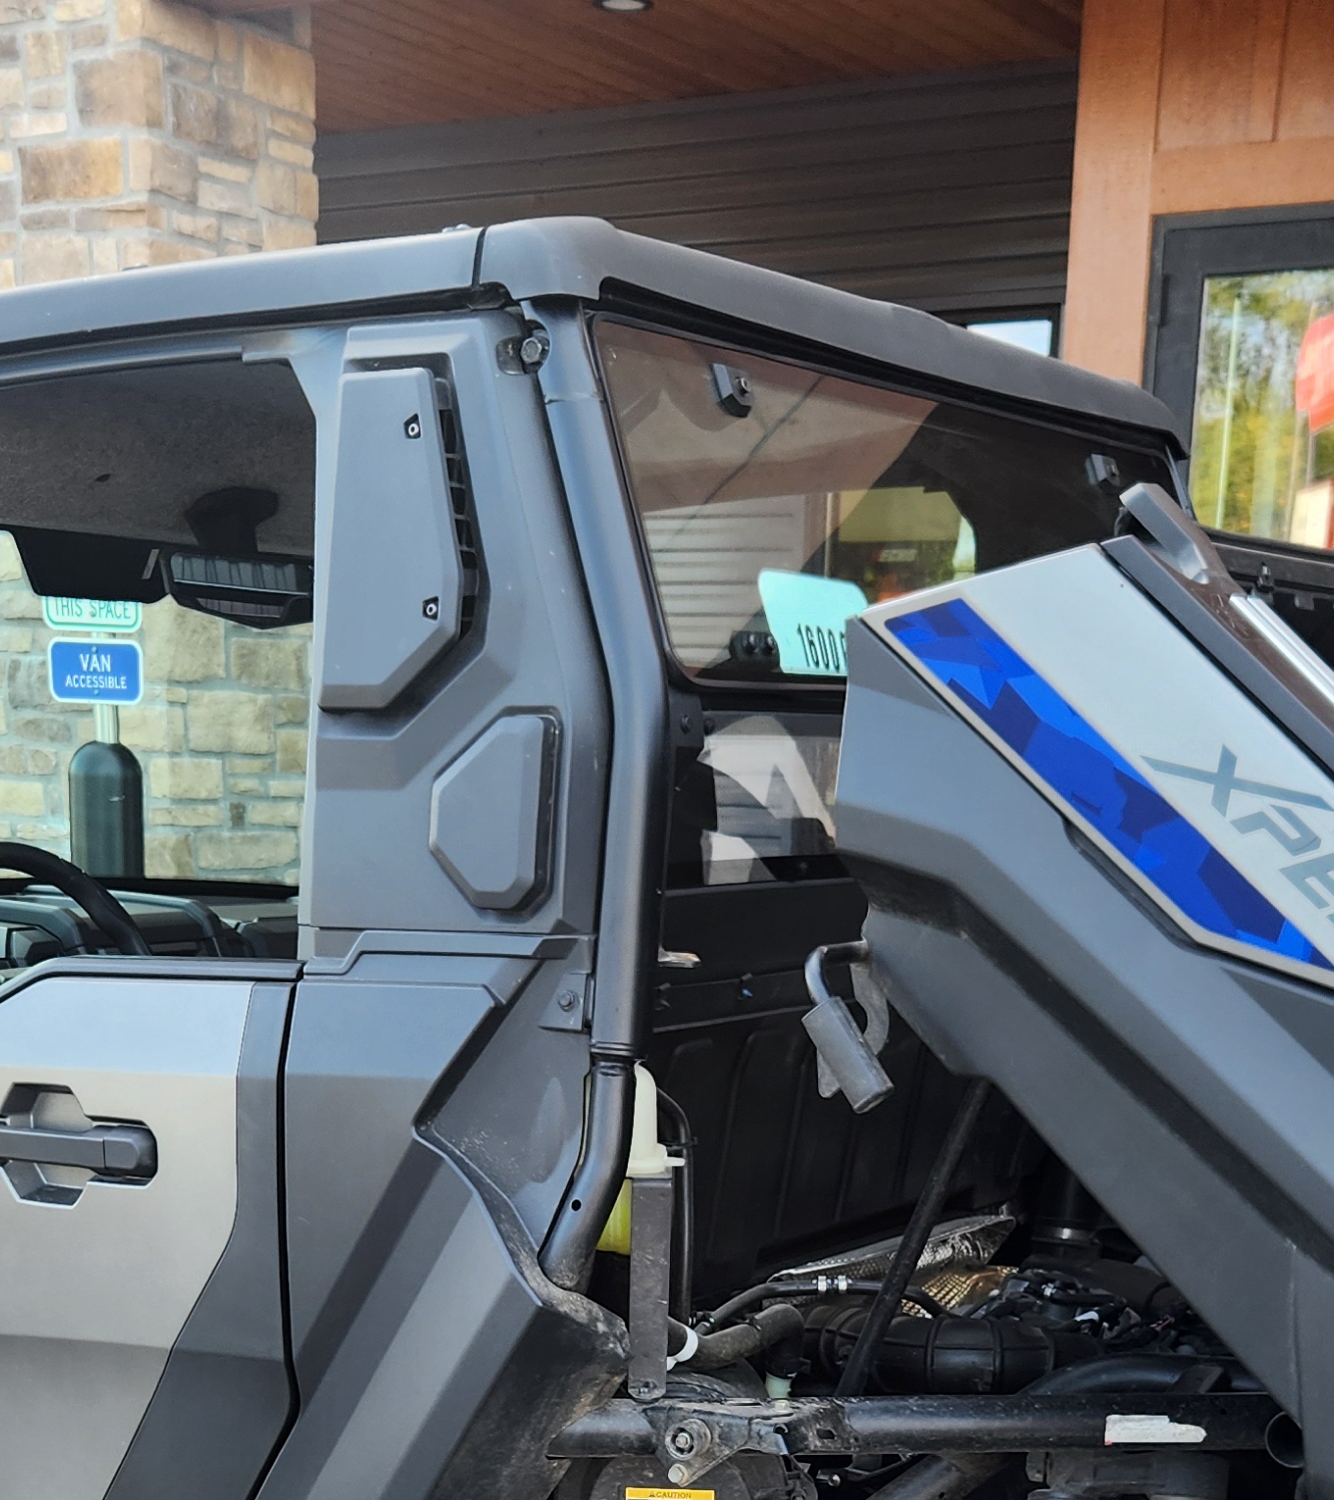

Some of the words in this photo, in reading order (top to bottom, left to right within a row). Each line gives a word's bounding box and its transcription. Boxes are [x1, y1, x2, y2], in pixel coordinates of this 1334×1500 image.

[79, 653, 111, 672] VAN
[65, 674, 127, 689] ACCESSIBLE
[656, 1491, 692, 1499] CAUTION
